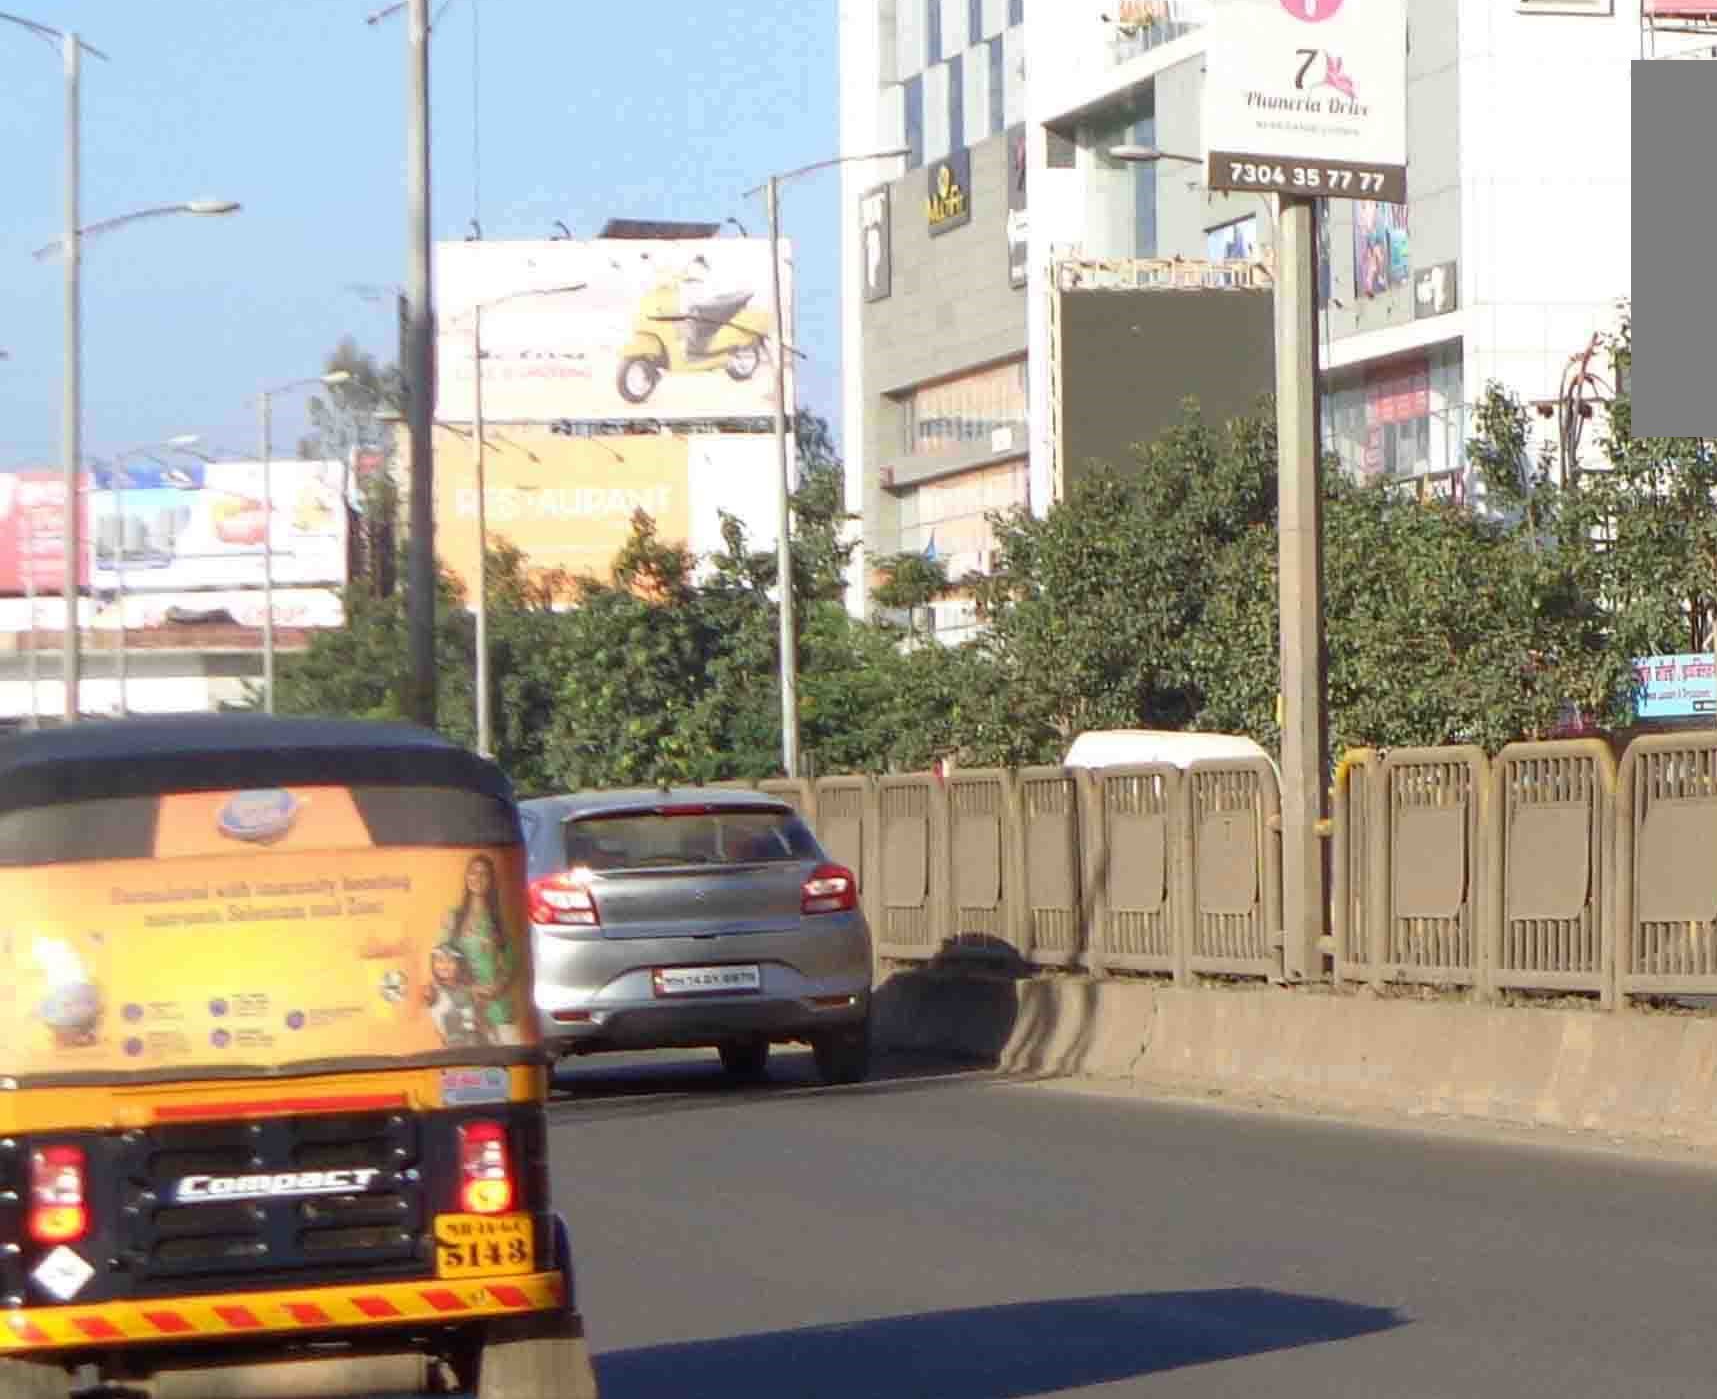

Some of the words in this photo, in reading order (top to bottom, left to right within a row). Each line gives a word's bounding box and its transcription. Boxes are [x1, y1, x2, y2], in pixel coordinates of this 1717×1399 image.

[1295, 48, 1319, 90] 7
[1230, 163, 1286, 185] 7304
[1293, 167, 1320, 187] 35
[1327, 170, 1353, 190] 77
[1359, 172, 1385, 192] 77
